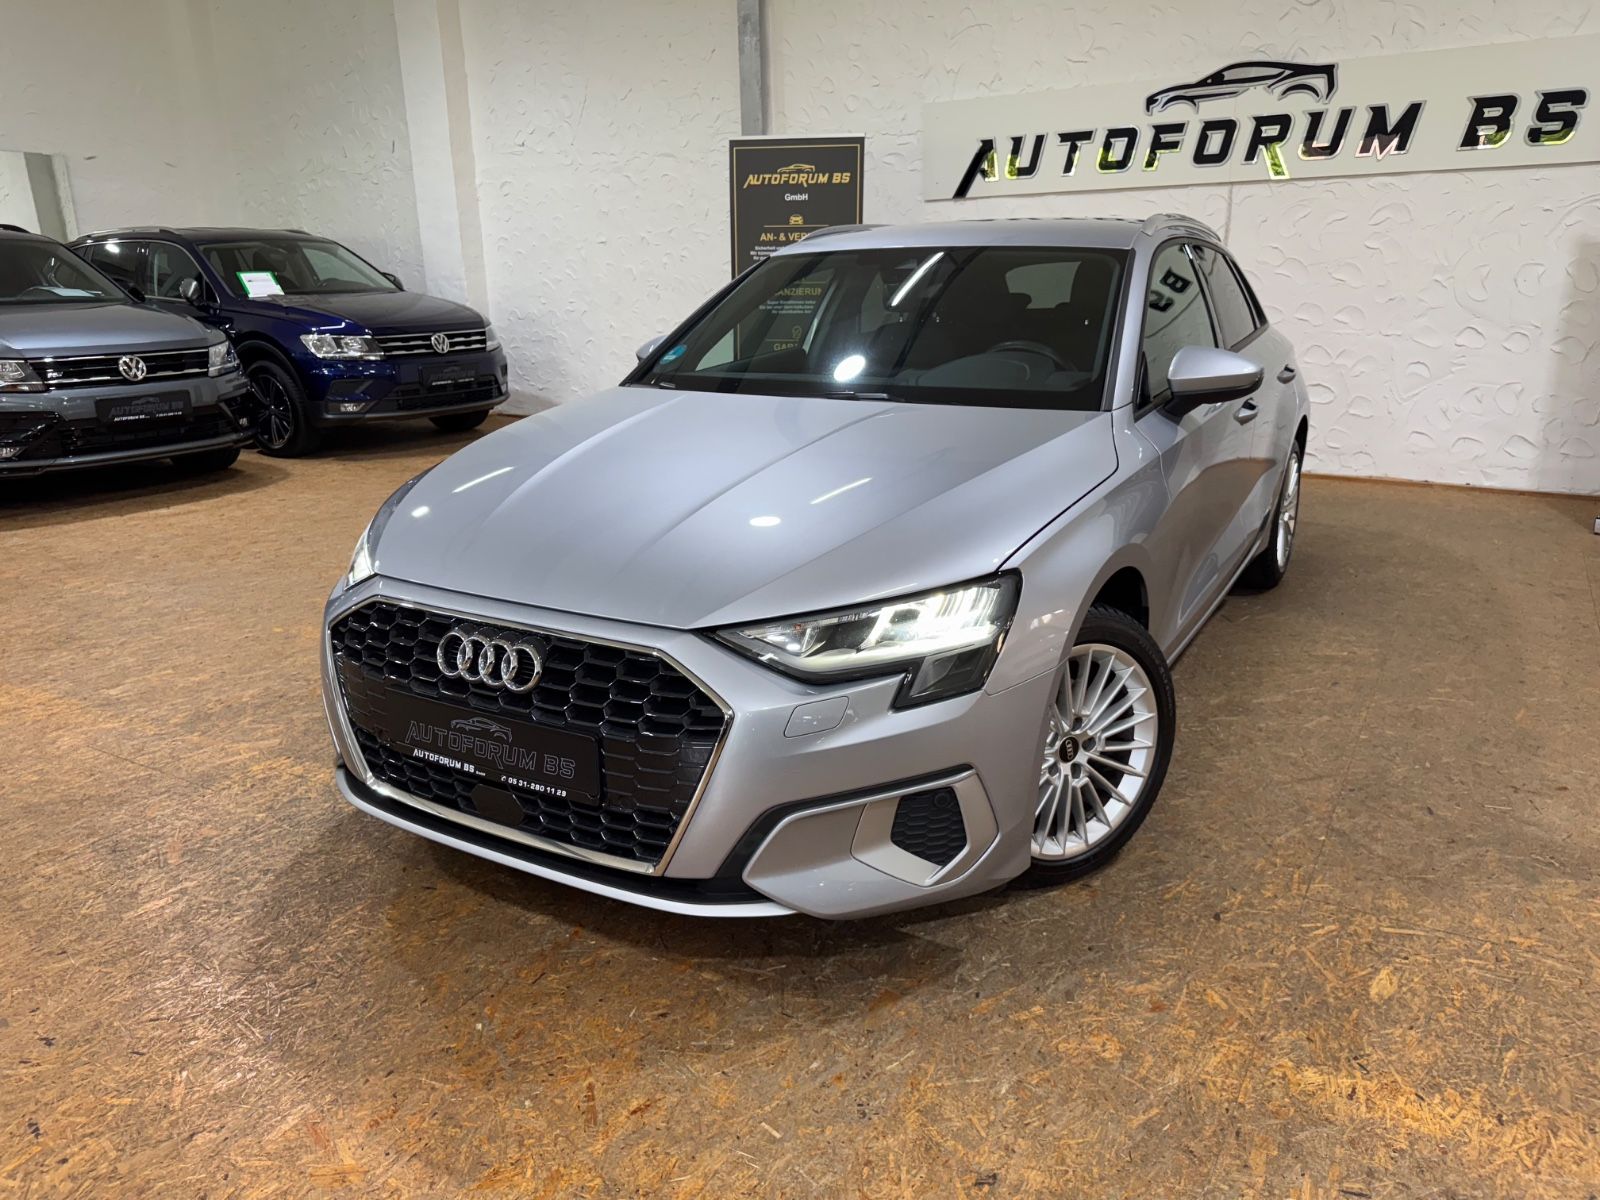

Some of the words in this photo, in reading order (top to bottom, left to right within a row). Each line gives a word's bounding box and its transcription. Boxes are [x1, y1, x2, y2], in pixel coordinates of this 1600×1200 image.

[953, 100, 1427, 200] AUTOFORUM
[1457, 87, 1589, 152] BS
[743, 173, 829, 189] AUTOFORUM
[831, 172, 851, 184] BS
[784, 193, 808, 201] GmbH
[760, 232, 777, 241] AN-
[779, 232, 786, 241] &
[788, 231, 809, 241] VER
[773, 343, 798, 351] GAR
[405, 720, 537, 771] AUTOFORUM
[543, 754, 576, 780] BS
[413, 748, 461, 769] AUTOFORUM
[463, 762, 475, 773] BS
[508, 777, 518, 785] 05
[546, 786, 555, 795] 11
